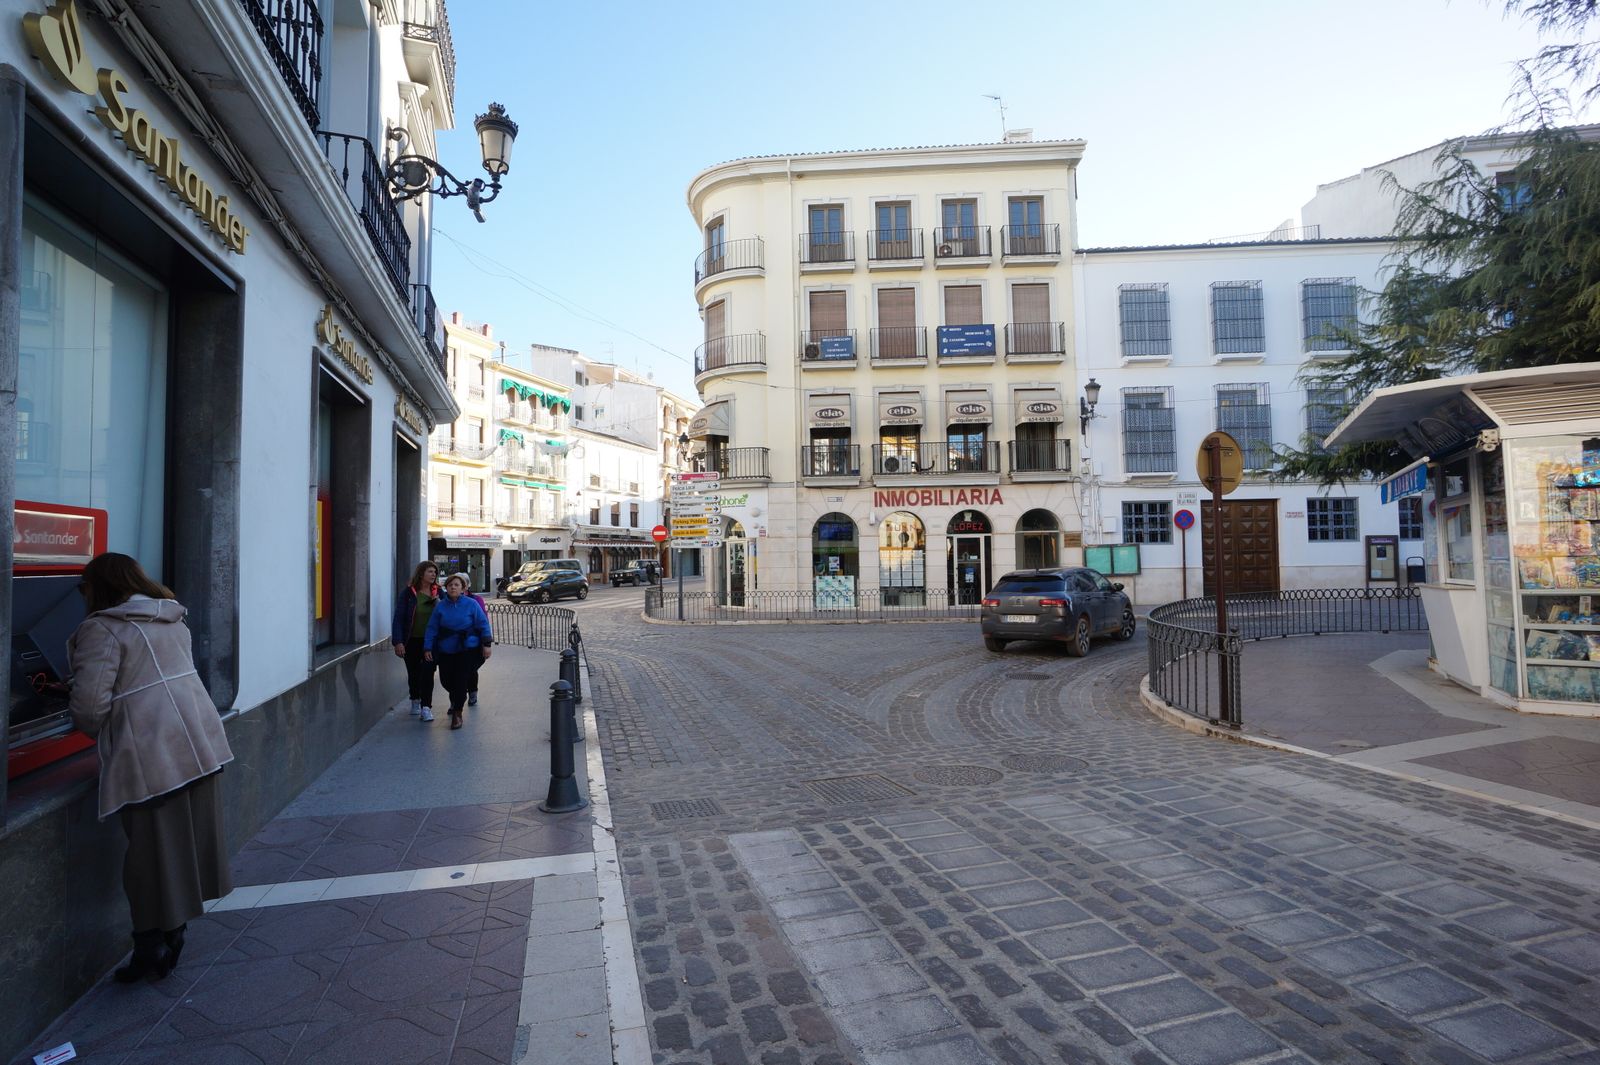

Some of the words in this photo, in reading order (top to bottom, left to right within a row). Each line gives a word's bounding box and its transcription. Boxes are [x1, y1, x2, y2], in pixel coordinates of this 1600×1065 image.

[96, 67, 250, 255] Santander
[333, 325, 373, 385] Santande
[888, 407, 915, 416] celas
[957, 404, 985, 414] celas
[1028, 403, 1056, 413] celas
[816, 409, 843, 418] celas
[874, 489, 1004, 507] INMOBILIARIA
[954, 521, 984, 531] LÓPEZ
[23, 528, 79, 545] Santander
[540, 536, 557, 544] cajasur
